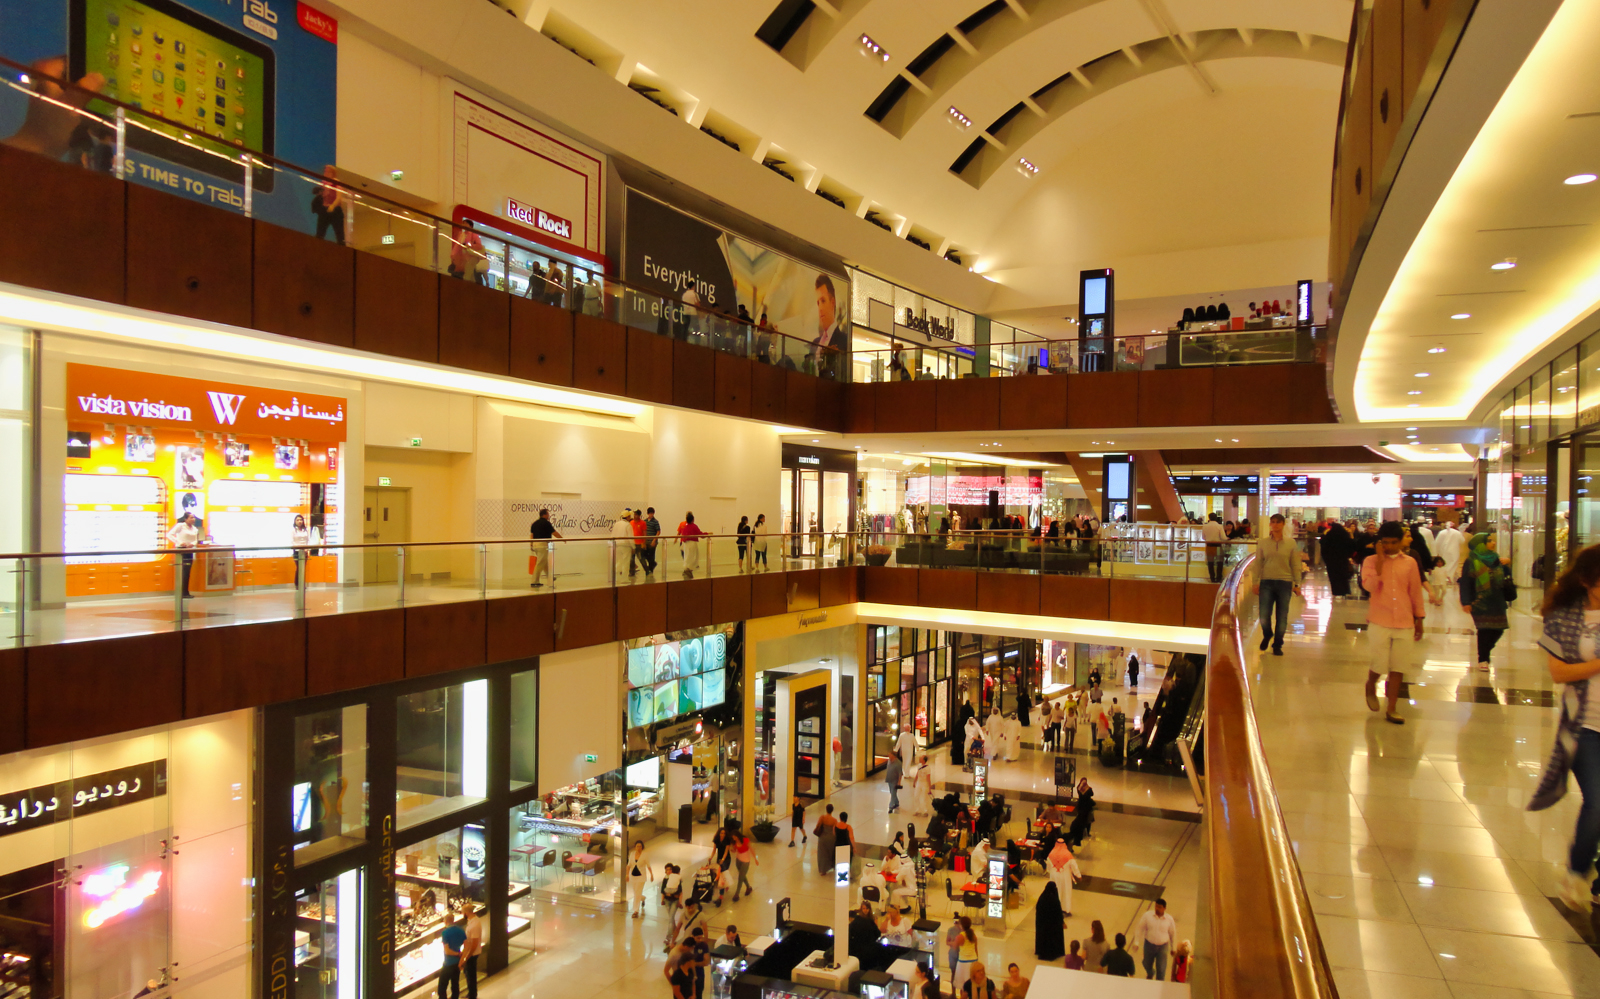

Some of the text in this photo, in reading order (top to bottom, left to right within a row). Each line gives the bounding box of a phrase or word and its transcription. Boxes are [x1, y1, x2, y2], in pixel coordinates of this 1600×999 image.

[305, 11, 333, 31] Jacky's
[139, 163, 179, 188] TIME
[183, 177, 204, 195] TO
[507, 199, 570, 238] Red Rock
[643, 254, 716, 304] Everything
[633, 291, 646, 313] in
[905, 306, 955, 341] Book World
[78, 392, 126, 416] vista
[128, 398, 192, 422] vision
[542, 503, 563, 513] SOON
[72, 776, 142, 808] روديو
